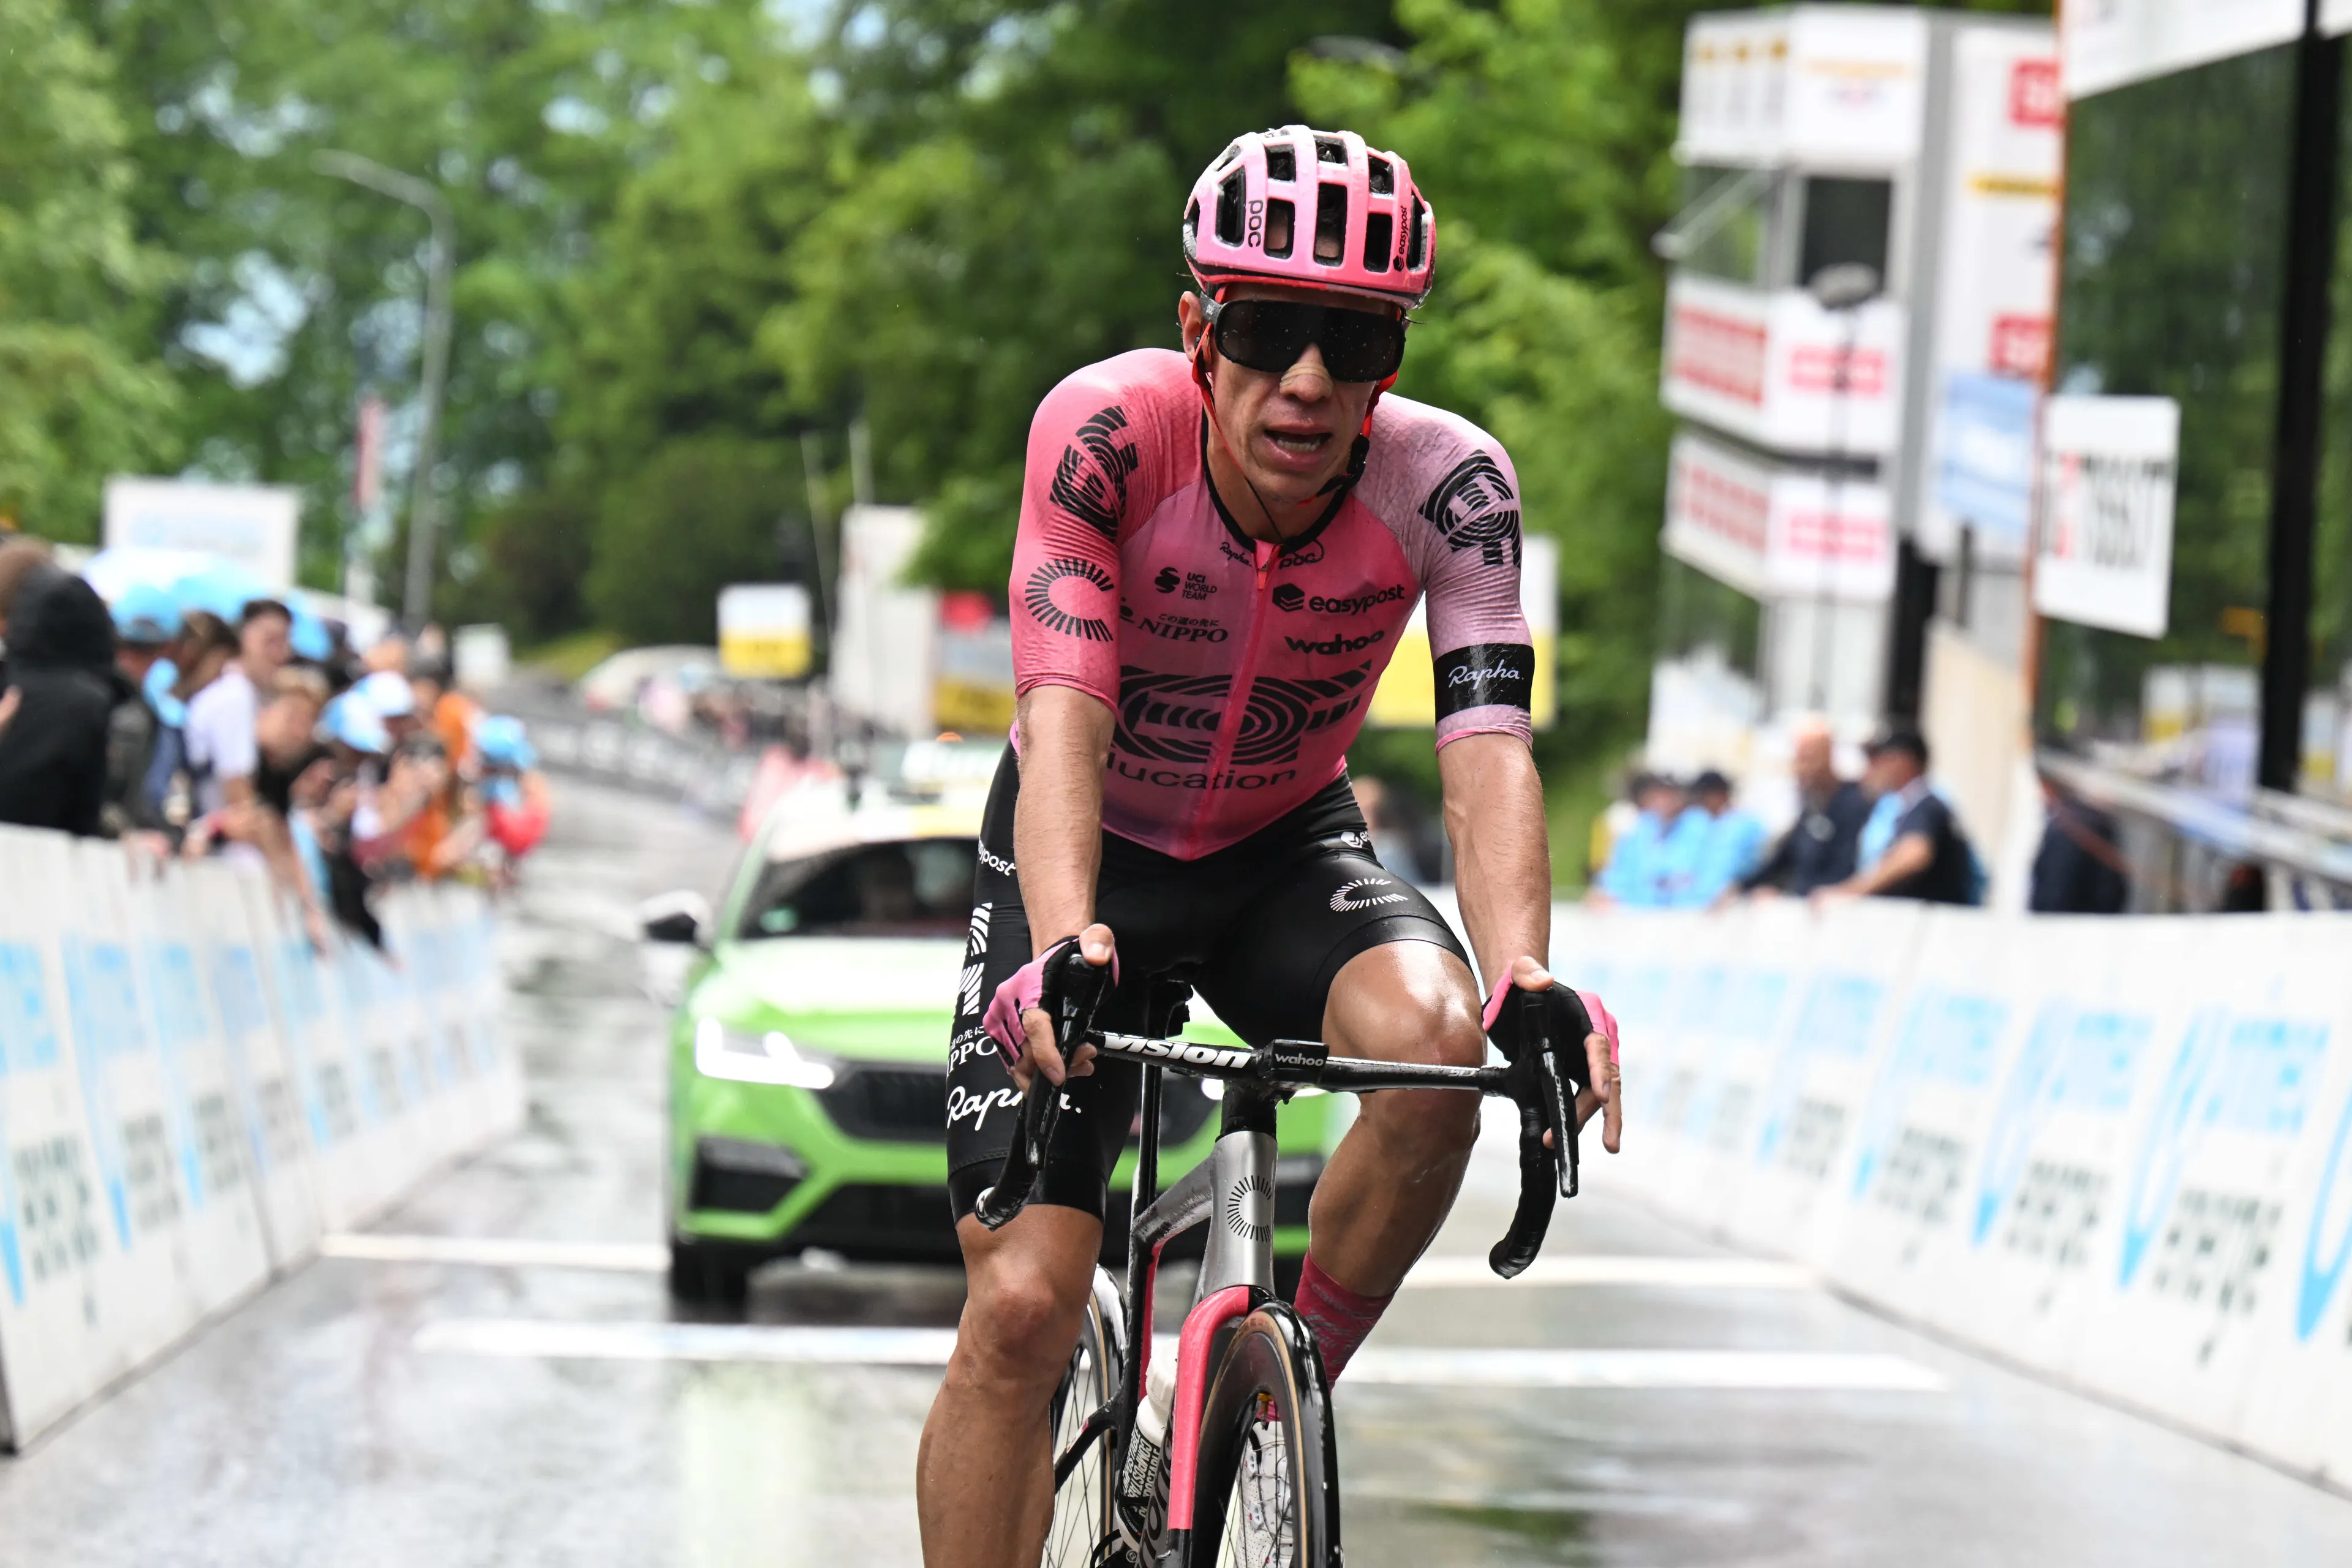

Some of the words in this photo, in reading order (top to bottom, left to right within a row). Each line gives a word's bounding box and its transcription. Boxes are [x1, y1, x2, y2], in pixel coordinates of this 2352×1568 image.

[1248, 200, 1264, 247] poc
[1398, 206, 1409, 255] easypost
[1185, 581, 1218, 594] WORLD
[1187, 572, 1206, 583] UCI
[1182, 589, 1207, 601] TEAM
[1309, 584, 1405, 616] easypost
[1137, 617, 1229, 643] NIPPO
[1284, 630, 1385, 655] wahoo
[1106, 751, 1297, 790] ucation
[1104, 1032, 1251, 1069] vision
[1275, 1052, 1324, 1067] wahoo
